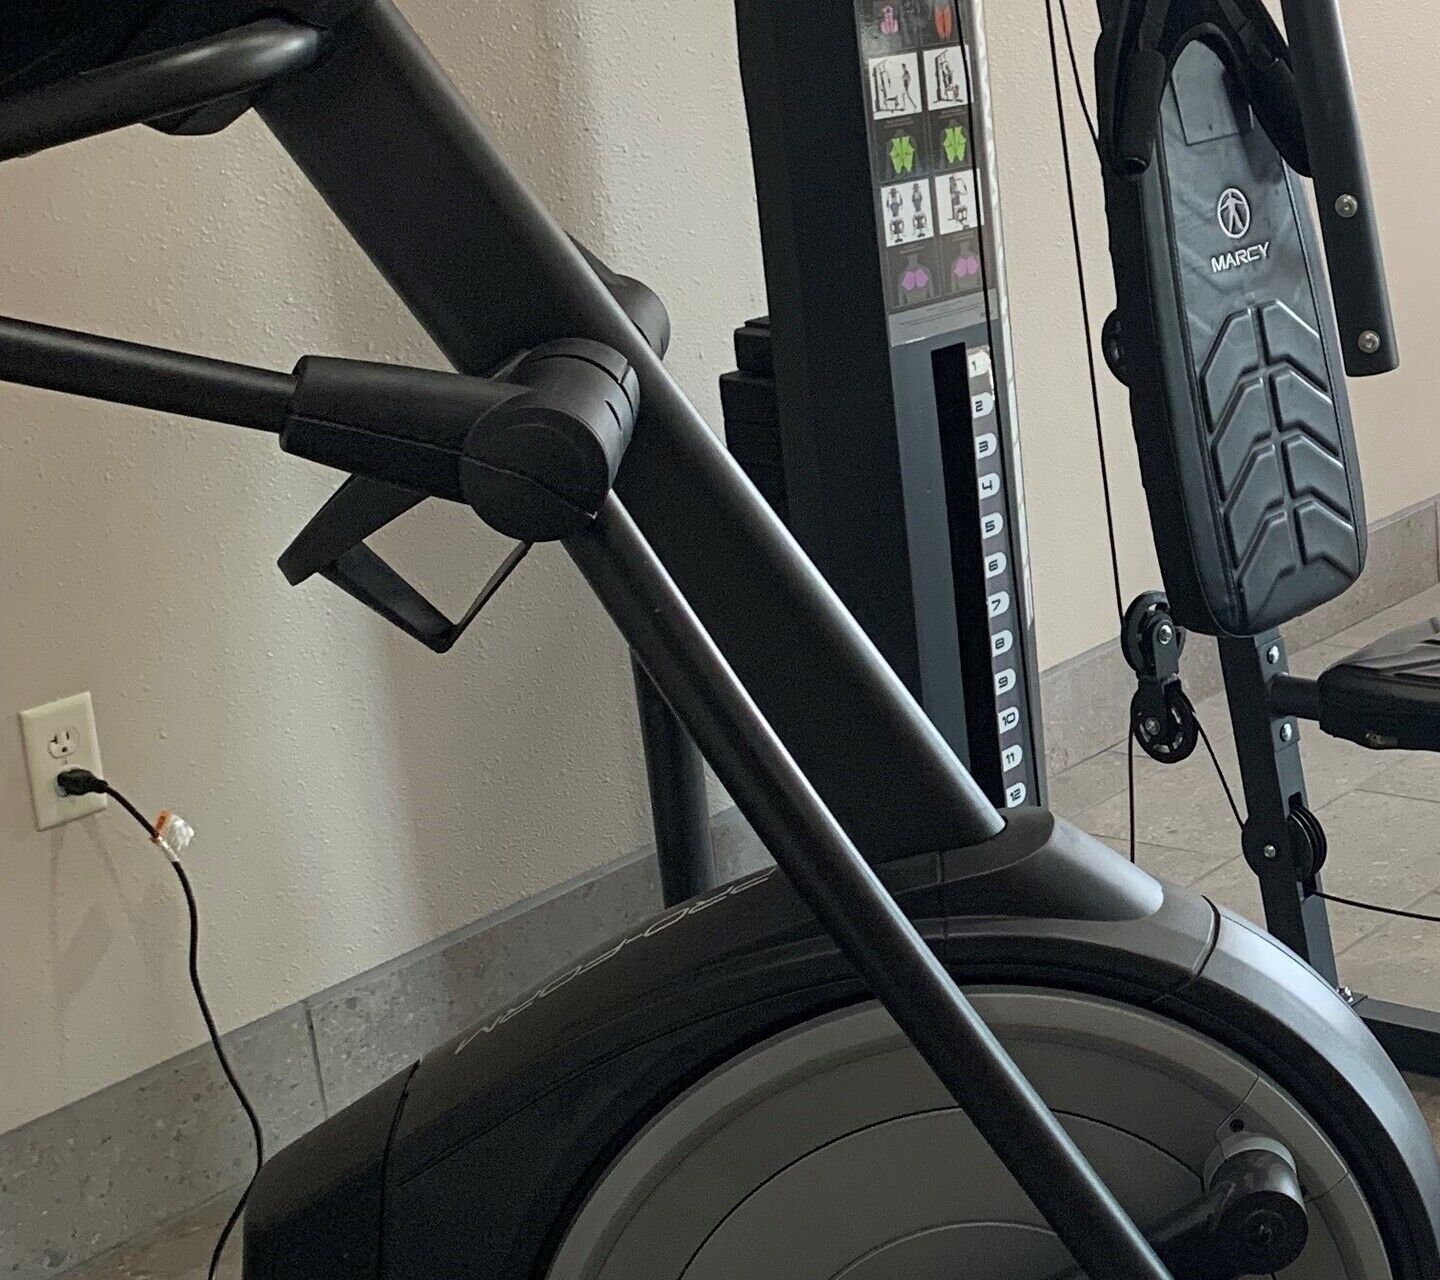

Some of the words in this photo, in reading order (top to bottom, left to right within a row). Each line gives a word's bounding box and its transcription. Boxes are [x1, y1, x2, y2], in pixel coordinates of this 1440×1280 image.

[1210, 241, 1270, 273] MARCY
[974, 400, 984, 413] 2
[978, 440, 989, 454] 3
[981, 479, 993, 491] 4
[985, 520, 996, 534] 5
[988, 559, 999, 572] 6
[991, 598, 1001, 612] 7
[995, 636, 1006, 650] 8
[998, 675, 1009, 689] 9
[1001, 711, 1016, 726] 10
[1005, 752, 1016, 766] 11
[1009, 787, 1022, 803] 12
